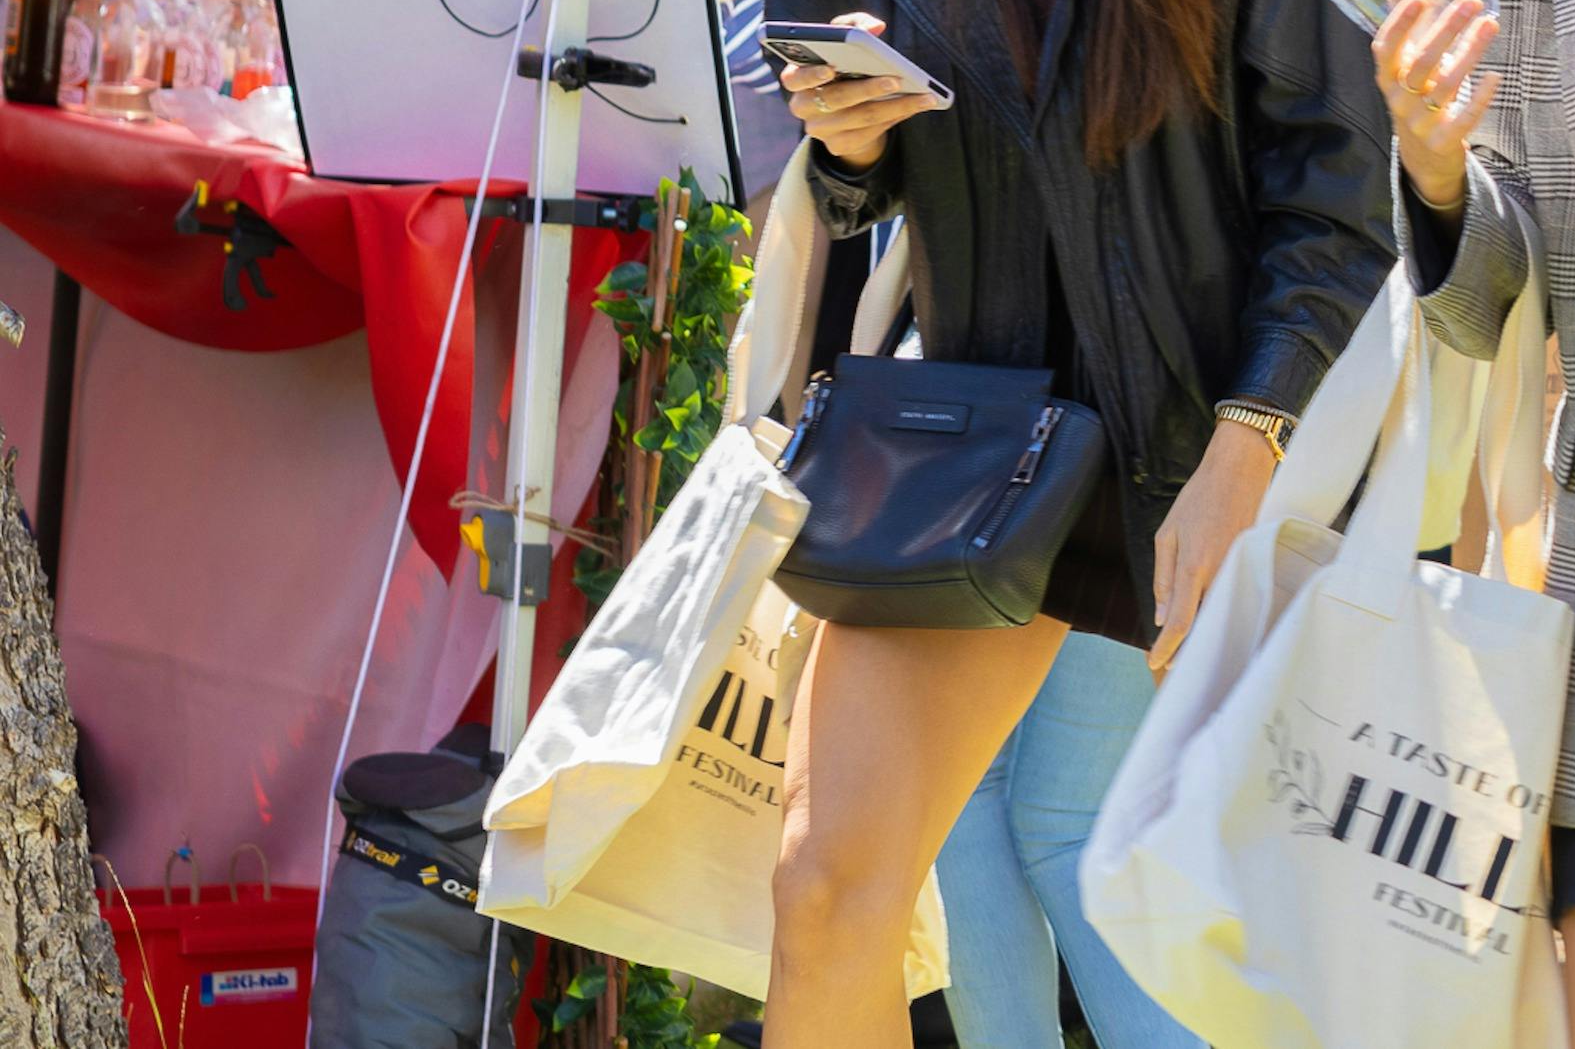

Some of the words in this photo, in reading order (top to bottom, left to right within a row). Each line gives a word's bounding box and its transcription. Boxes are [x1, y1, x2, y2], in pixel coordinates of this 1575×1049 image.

[696, 670, 790, 768] ILL
[674, 745, 780, 807] FESTIVAL
[1348, 722, 1375, 750] A
[1389, 731, 1500, 798] TASTE
[1331, 772, 1546, 919] HILL
[1372, 882, 1511, 955] FESTIVAL
